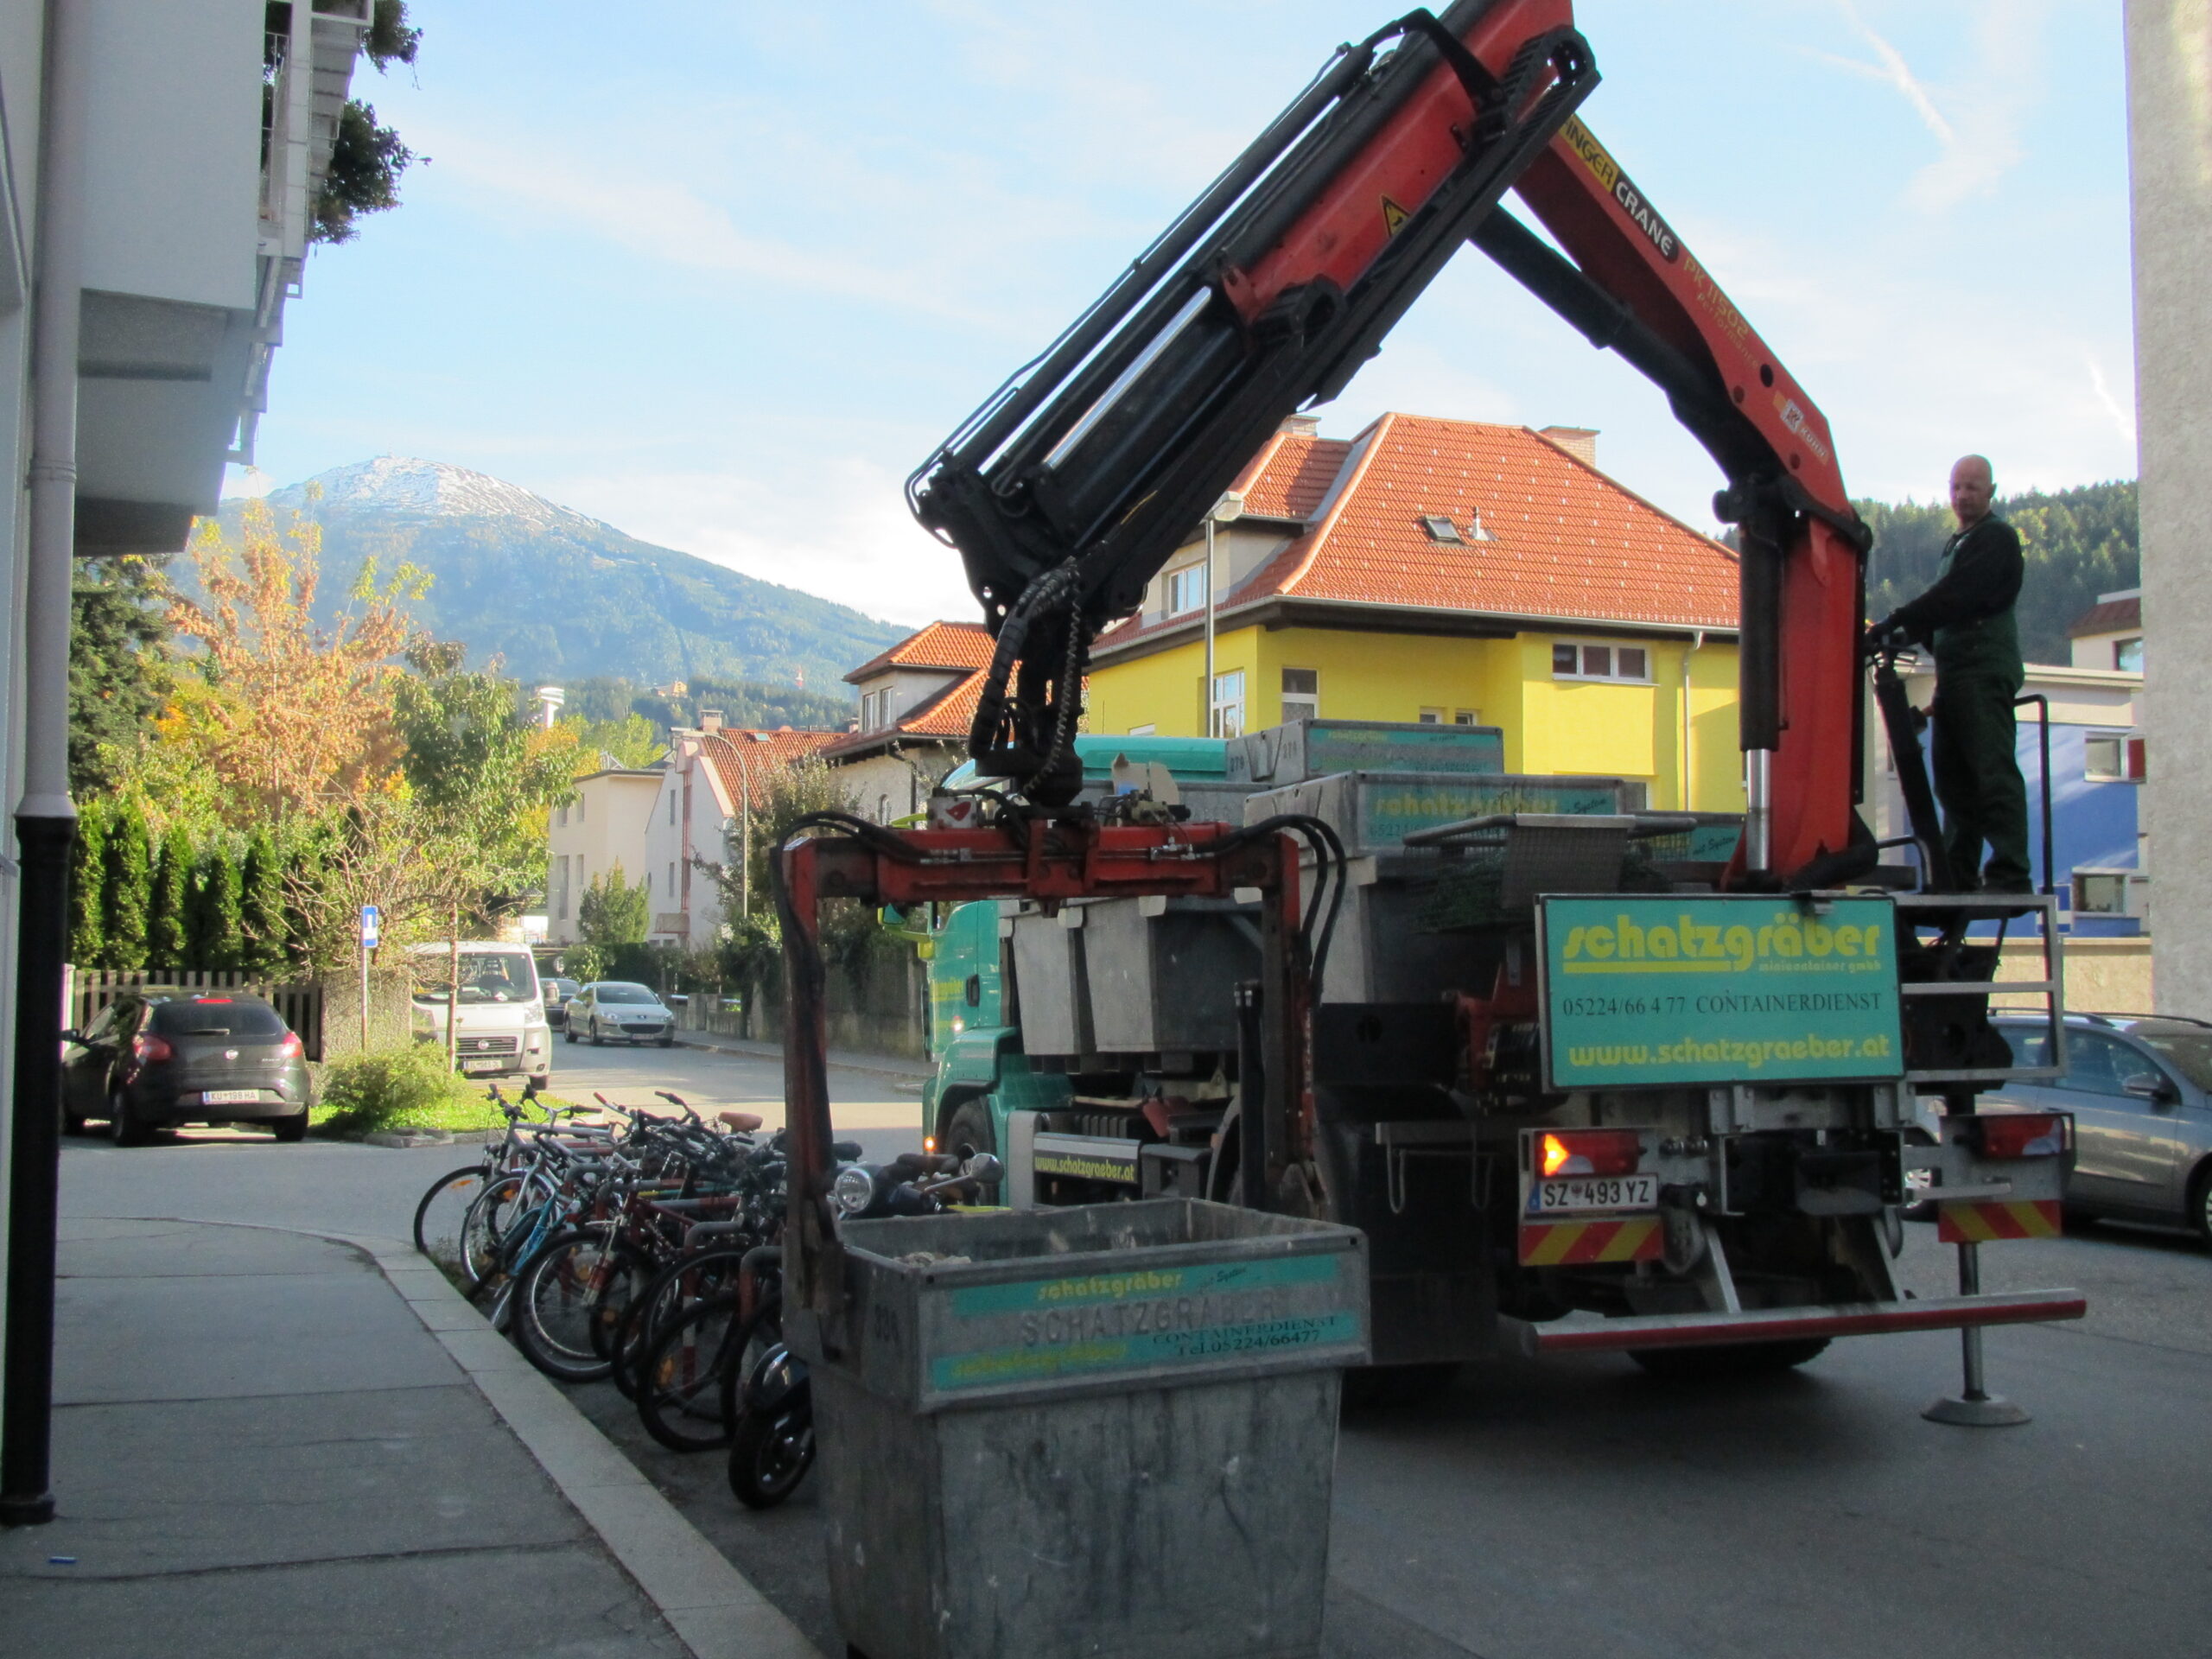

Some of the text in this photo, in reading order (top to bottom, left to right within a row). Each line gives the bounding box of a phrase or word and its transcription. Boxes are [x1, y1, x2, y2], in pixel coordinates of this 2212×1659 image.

[1563, 119, 1674, 257] INGER CRANE
[1683, 256, 1707, 286] PK
[1562, 912, 1881, 972] schatzgräber
[1562, 992, 1882, 1017] 05224/66 4 77 CONTAINERDIENST
[1569, 1033, 1891, 1070] www.schatzgraeber.at
[1034, 1154, 1135, 1182] www.schatzgraeber.at
[1544, 1183, 1568, 1207] SZ
[1585, 1181, 1621, 1205] 493
[1625, 1179, 1649, 1204] YZ
[1154, 1316, 1336, 1344] CONTAINERDIENST
